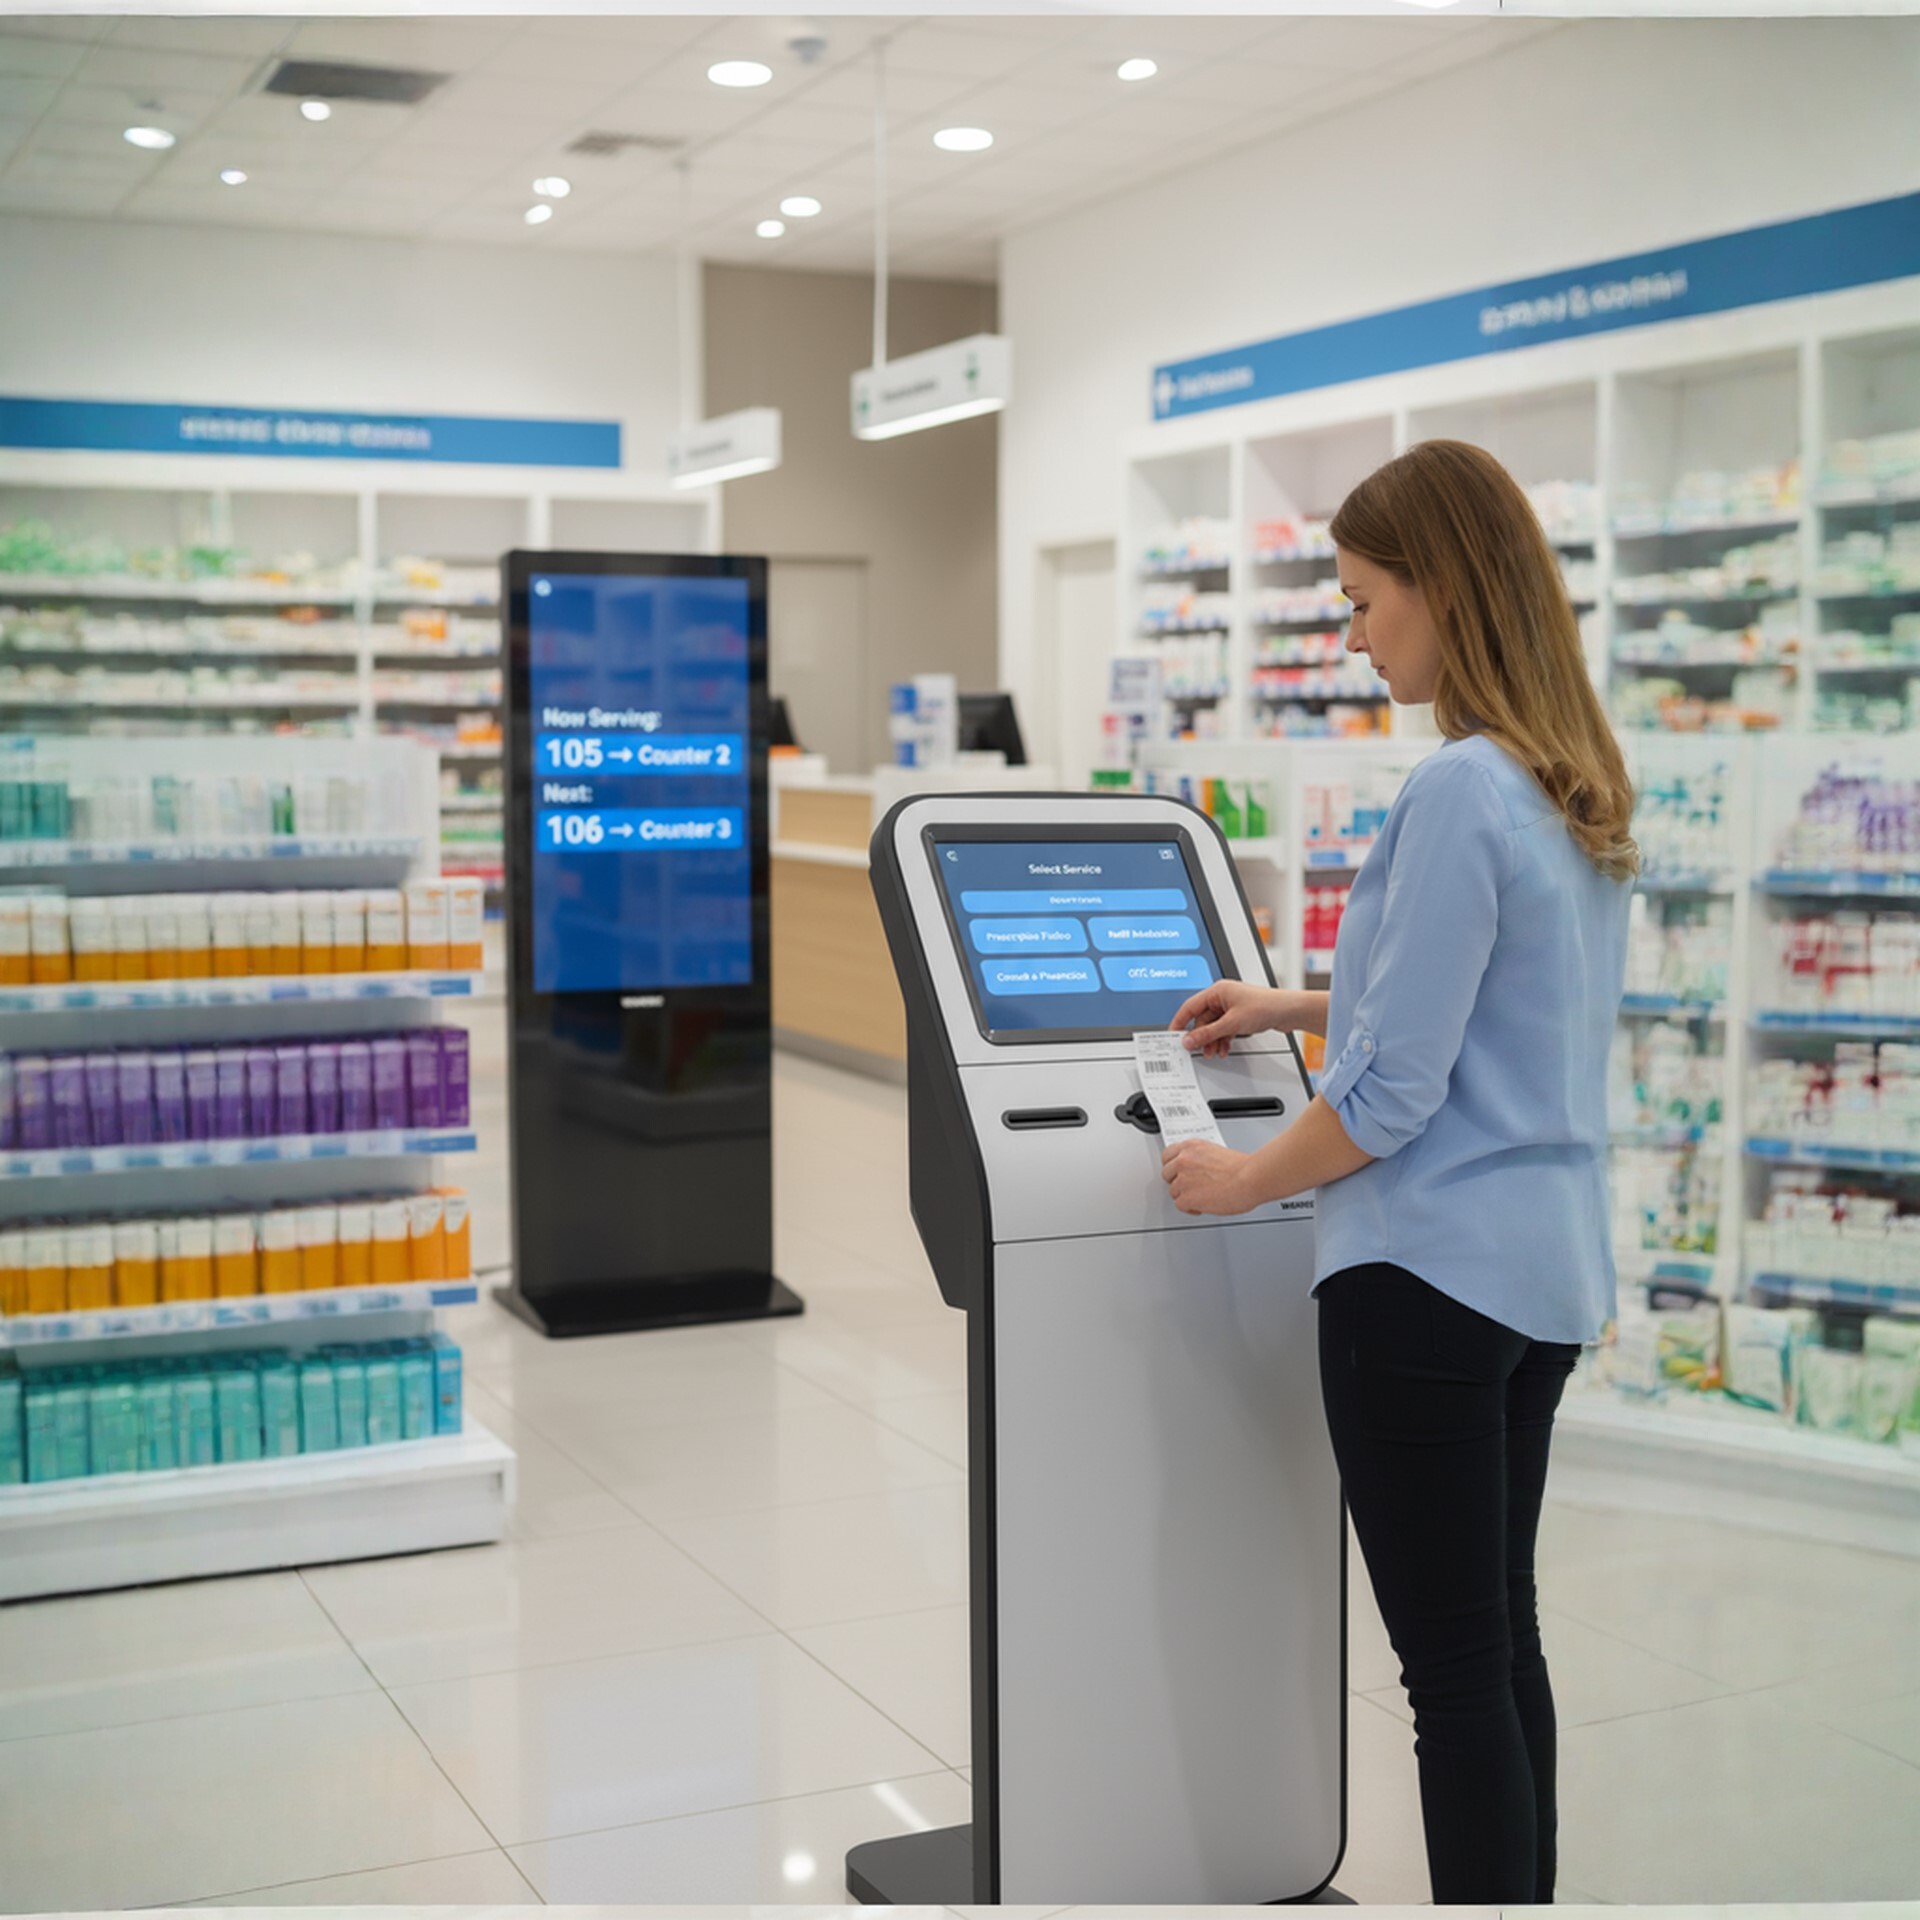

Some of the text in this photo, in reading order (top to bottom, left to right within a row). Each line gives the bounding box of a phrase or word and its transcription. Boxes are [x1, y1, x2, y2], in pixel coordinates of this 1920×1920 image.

[543, 707, 662, 733] Now Serving:
[546, 738, 731, 768] 105 Counter 2
[543, 782, 594, 804] Next:
[547, 815, 732, 845] 106 Counter 3
[1028, 863, 1102, 875] Select Service
